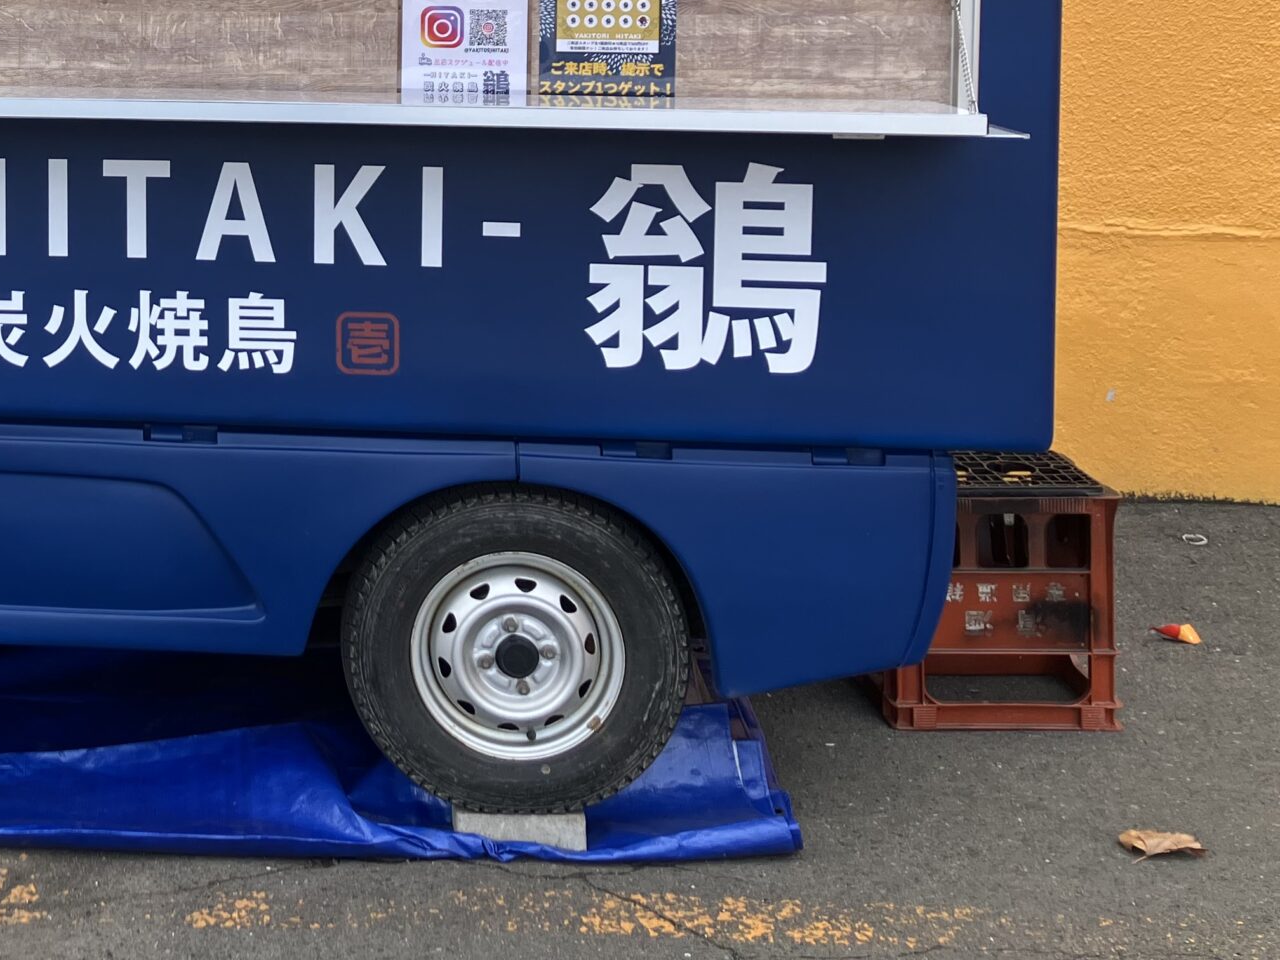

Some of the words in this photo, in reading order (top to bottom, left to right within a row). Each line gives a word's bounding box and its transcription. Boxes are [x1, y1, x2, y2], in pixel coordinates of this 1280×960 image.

[550, 62, 664, 76] ご来店時、提示で
[539, 81, 671, 95] スタンプ1つゲット！
